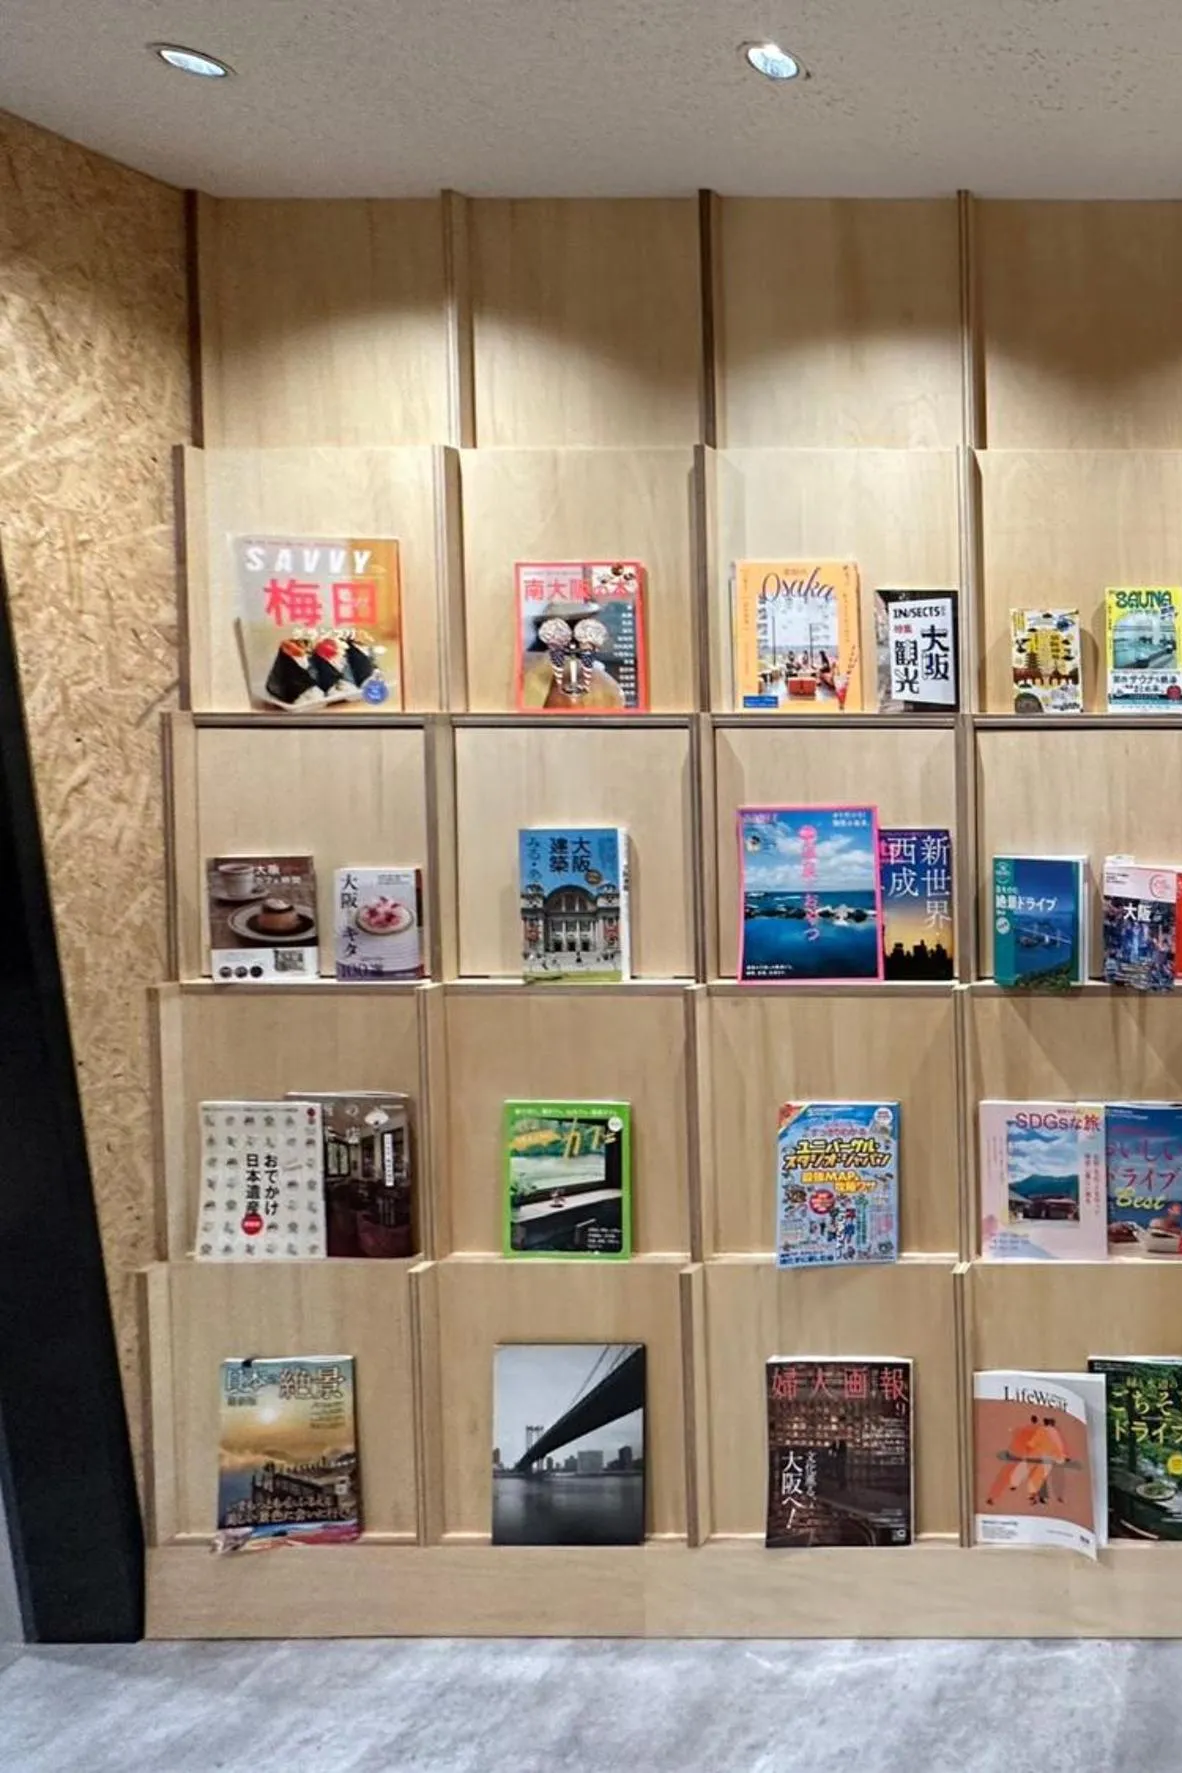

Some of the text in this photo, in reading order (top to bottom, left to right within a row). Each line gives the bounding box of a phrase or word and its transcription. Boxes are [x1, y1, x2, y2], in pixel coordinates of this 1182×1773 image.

[244, 546, 372, 574] SAVVY
[263, 578, 377, 628] 梅田
[761, 565, 836, 604] Osaka
[1115, 590, 1173, 609] SAUNA
[894, 639, 920, 694] 観光
[920, 623, 950, 681] 大阪
[570, 836, 592, 873] 大阪
[887, 836, 920, 898] 西成
[1123, 902, 1152, 922] 大阪
[772, 1367, 909, 1401] 婦人画報
[1003, 1386, 1069, 1414] LifeWear
